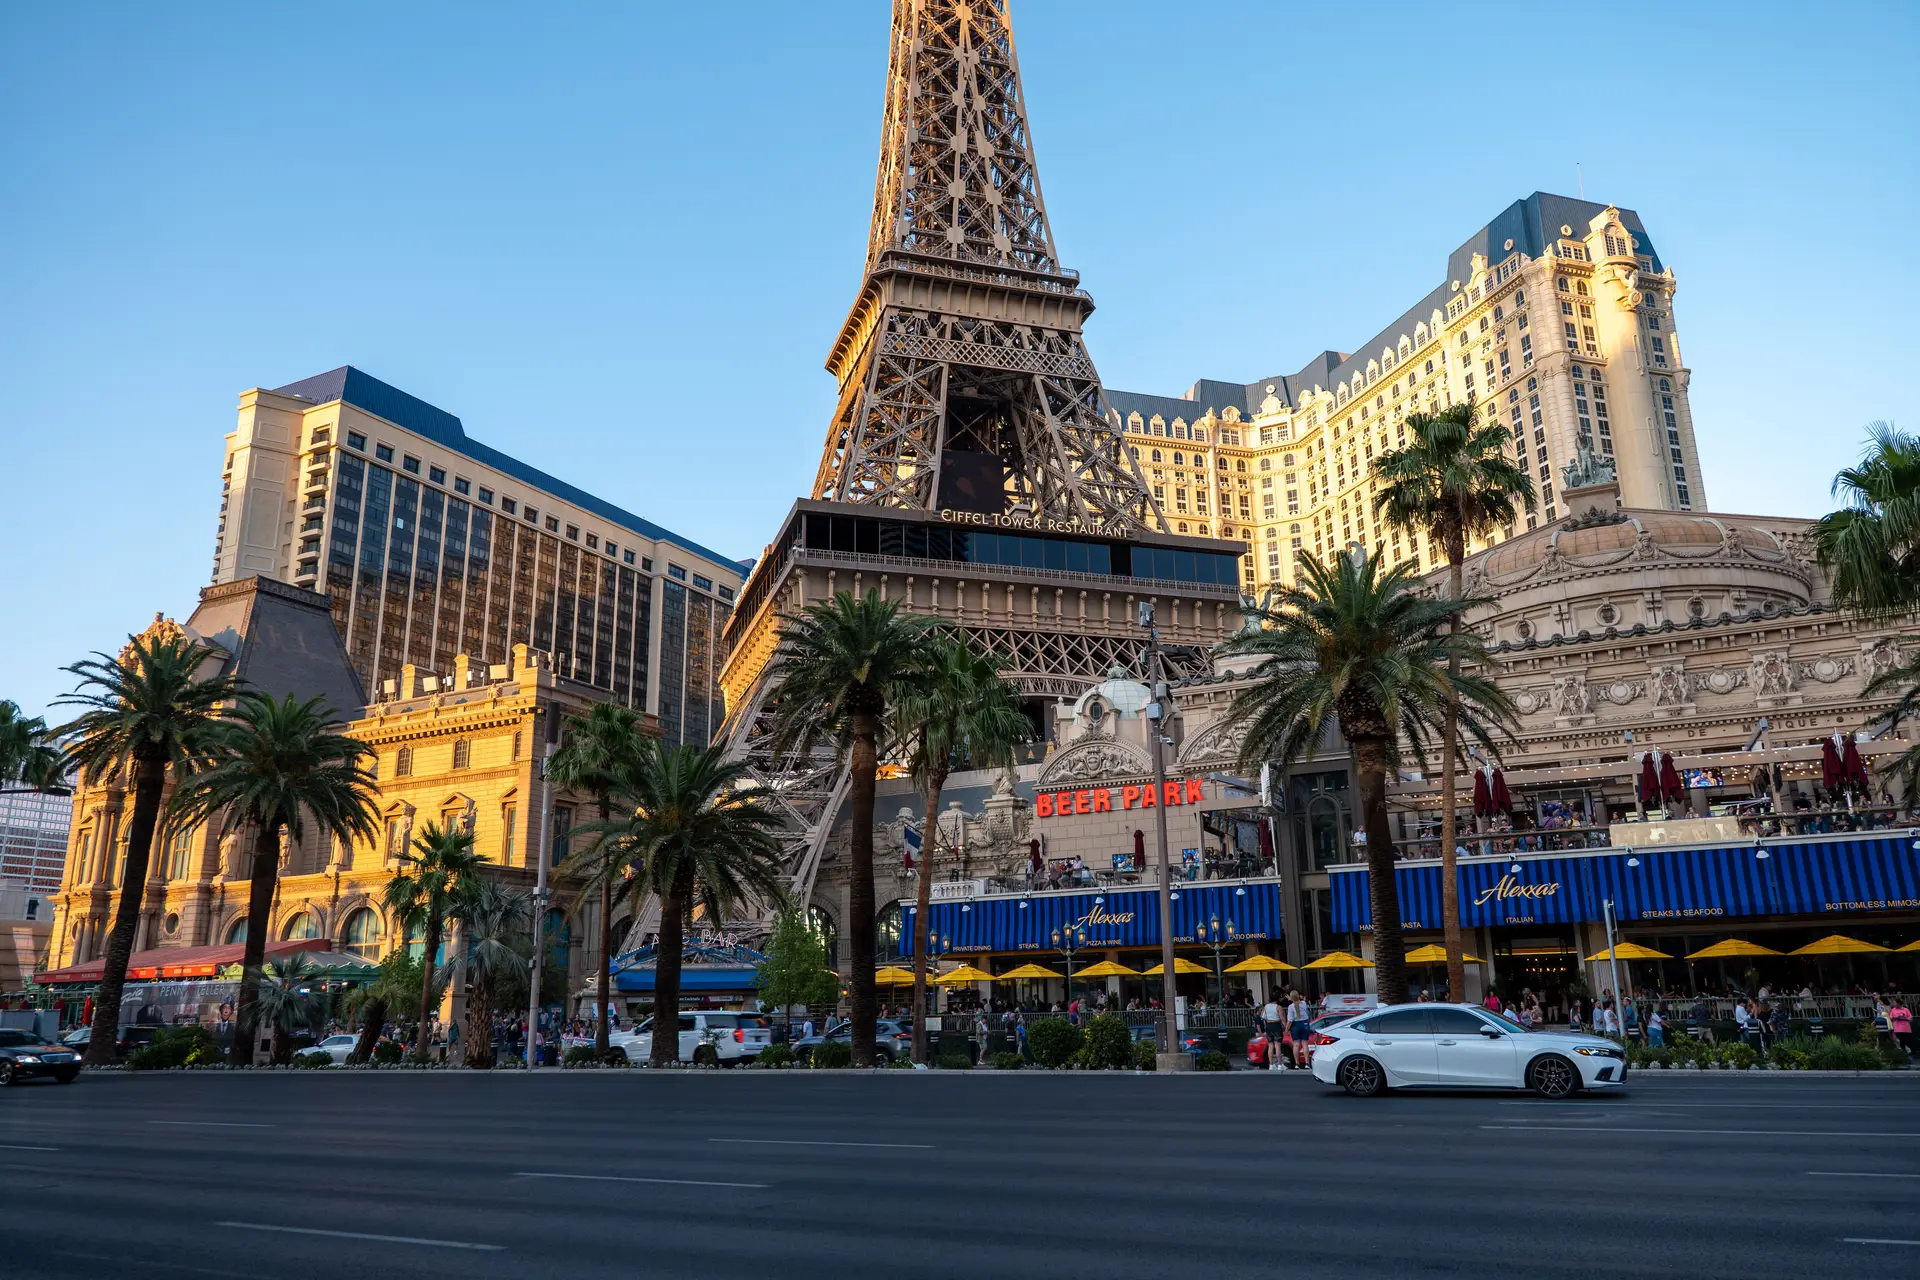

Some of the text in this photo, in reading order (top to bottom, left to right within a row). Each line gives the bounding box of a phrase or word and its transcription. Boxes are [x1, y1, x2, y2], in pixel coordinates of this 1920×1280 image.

[941, 508, 1128, 538] EIFFEL TOWER RESTAURANT
[1562, 733, 1653, 750] NATIONLE
[1687, 728, 1707, 738] DE
[1742, 718, 1818, 733] MSIQUE
[1036, 778, 1205, 817] BEER PARK
[1642, 907, 1724, 918] STEAKS & SEAFOOD
[1825, 900, 1886, 910] BOTTOMLESS
[1505, 916, 1534, 924] ITALIAN
[700, 928, 738, 950] BAR
[160, 986, 184, 997] PENN
